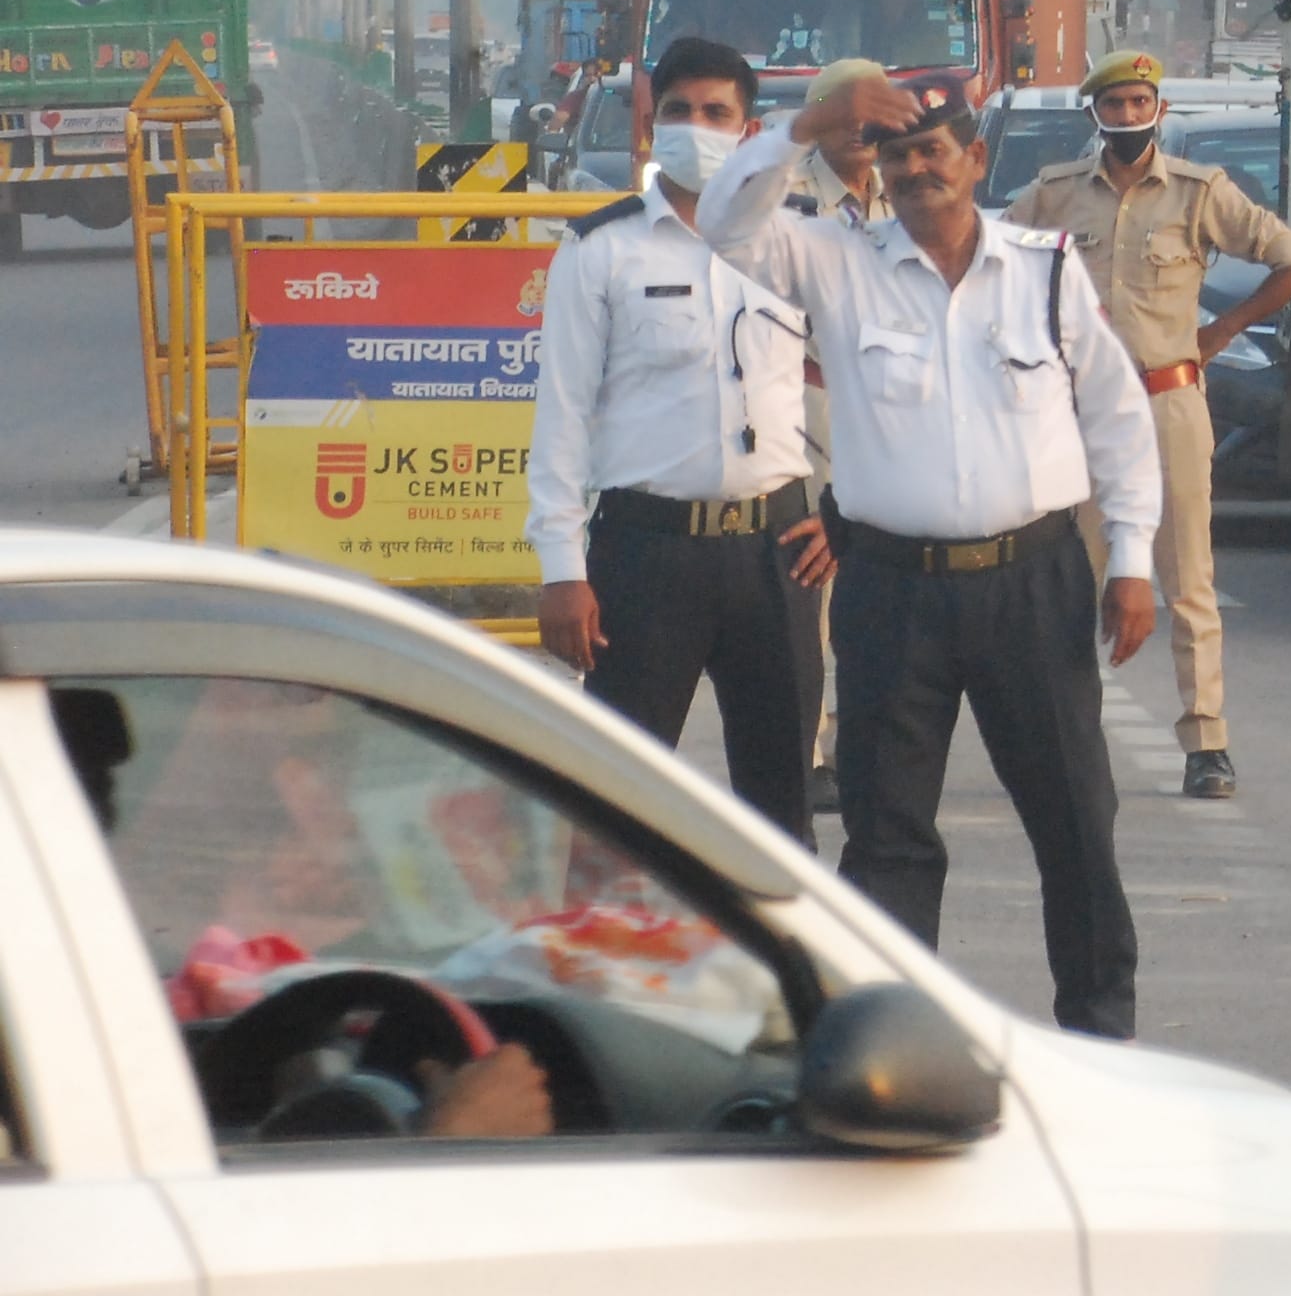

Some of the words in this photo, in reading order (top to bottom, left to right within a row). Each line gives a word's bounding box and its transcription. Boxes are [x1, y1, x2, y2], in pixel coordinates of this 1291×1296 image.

[346, 338, 490, 363] यातायात
[391, 381, 475, 398] यातायात
[374, 448, 417, 475] JK
[408, 480, 504, 497] CEMENT
[407, 507, 457, 521] BUILD
[461, 507, 503, 521] SAFE
[359, 536, 373, 553] के
[379, 540, 410, 559] सुपर
